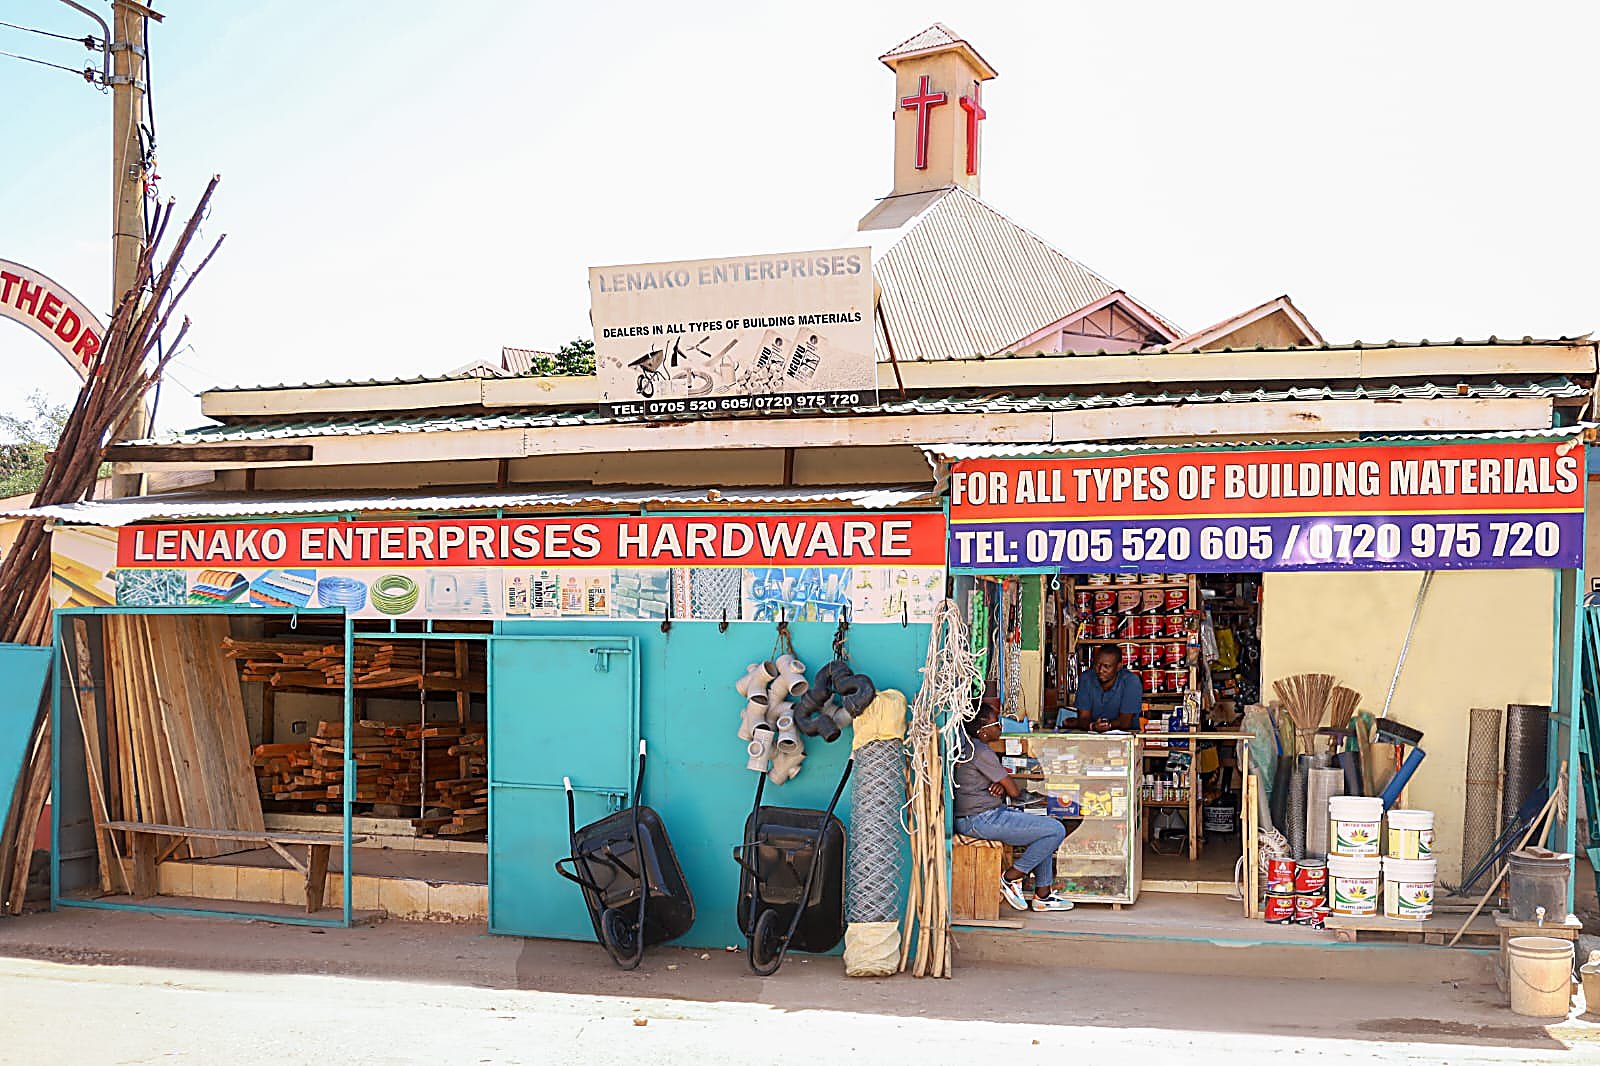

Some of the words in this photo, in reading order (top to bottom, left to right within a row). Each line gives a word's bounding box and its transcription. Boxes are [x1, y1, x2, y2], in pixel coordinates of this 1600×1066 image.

[600, 270, 690, 292] LENAKO
[698, 255, 861, 285] ENTERPRISES
[0, 271, 104, 376] THEDR
[603, 326, 650, 338] DEALERS
[652, 325, 664, 335] IN
[666, 323, 686, 334] ALL
[689, 320, 723, 333] TYPES
[725, 319, 740, 330] OF
[743, 315, 795, 328] BUILDING
[798, 312, 862, 325] MATERIALS
[786, 344, 806, 378] NGUVU
[611, 404, 644, 415] TEL:
[649, 402, 685, 413] 0705
[689, 400, 717, 411] 520
[796, 395, 826, 406] 975
[830, 394, 859, 405] 720
[952, 469, 1008, 506] FOR
[1015, 468, 1067, 504] ALL
[1072, 465, 1170, 503] TYPES
[1177, 463, 1217, 501] OF
[1223, 460, 1381, 499] BUILDING
[1389, 456, 1579, 496] MATERIALS
[134, 527, 288, 562] LENAKO
[300, 523, 602, 562] ENTERPRISES
[617, 519, 913, 560] HARDWARE
[955, 530, 1018, 564] TEL:
[1026, 528, 1113, 563] 0705
[1121, 527, 1190, 562] 520
[1200, 525, 1273, 560] 605
[1281, 524, 1301, 560] /
[1309, 523, 1402, 559] 0720
[1410, 522, 1481, 558] 975
[1489, 521, 1560, 557] 720
[534, 581, 544, 608] NGUVU
